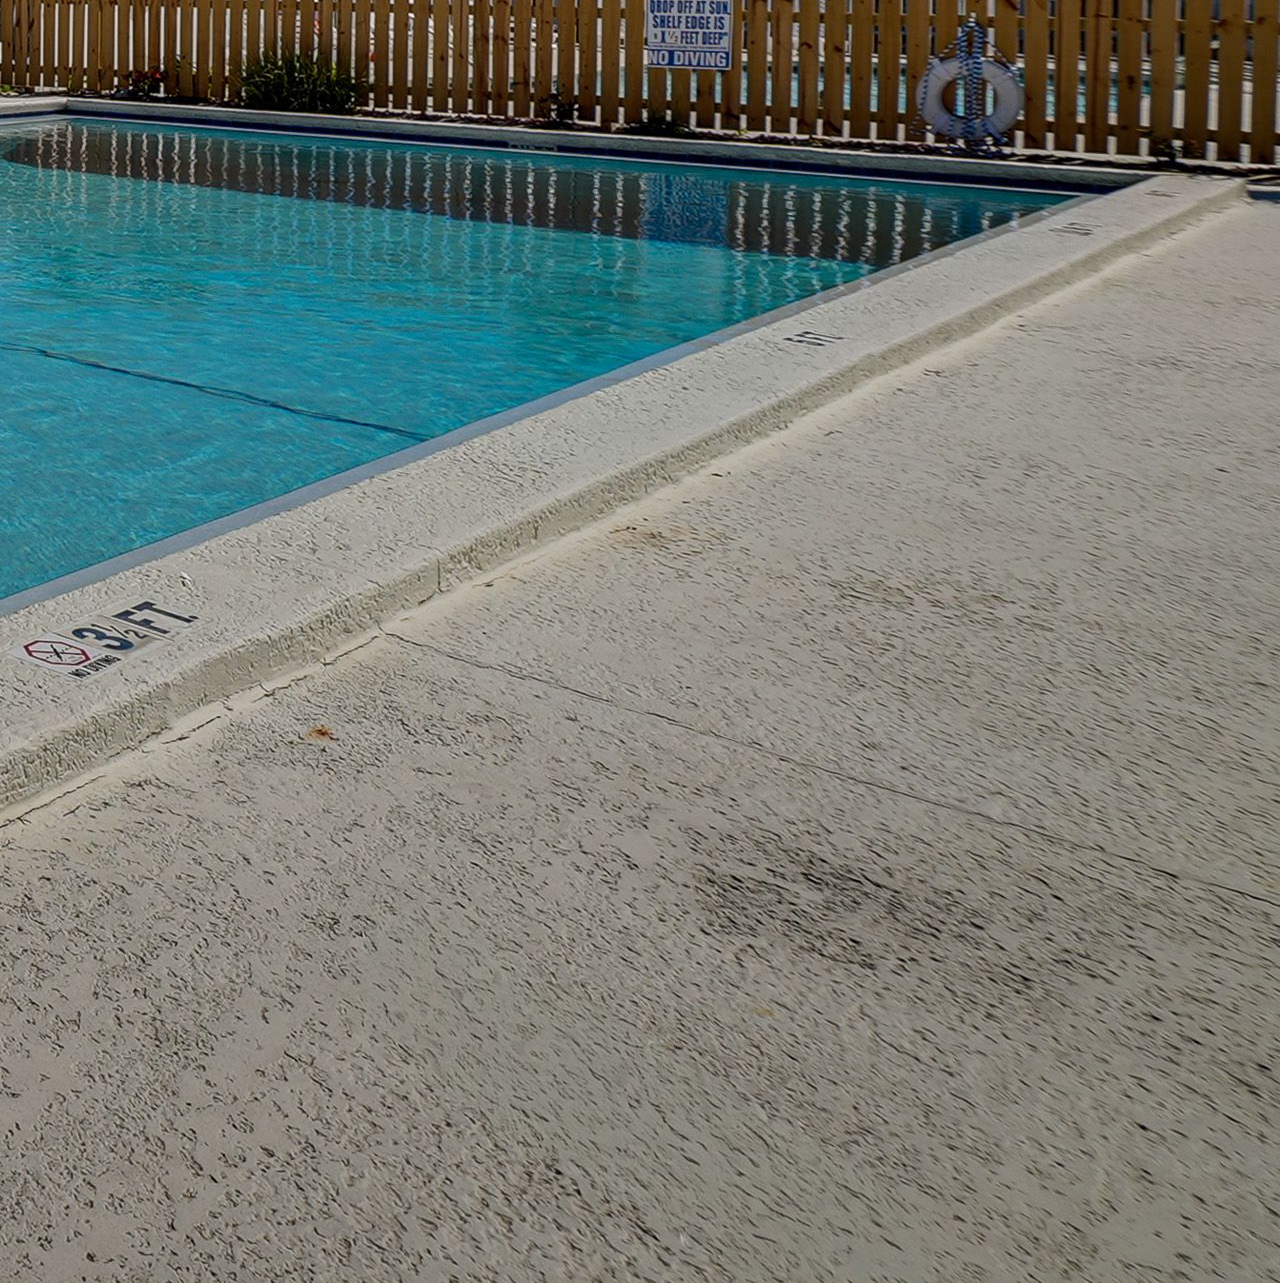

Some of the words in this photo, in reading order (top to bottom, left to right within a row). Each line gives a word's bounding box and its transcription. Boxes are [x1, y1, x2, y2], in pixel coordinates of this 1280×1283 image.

[650, 0, 675, 14] DROP
[677, 0, 694, 14] OFF
[696, 1, 707, 14] AT
[653, 15, 682, 29] SHELF
[685, 16, 712, 29] EDGE
[714, 17, 725, 30] IS
[681, 31, 699, 44] FEET
[648, 51, 669, 64] NO
[674, 51, 727, 67] DIVING
[68, 668, 92, 678] NO
[82, 654, 122, 673] DIVING
